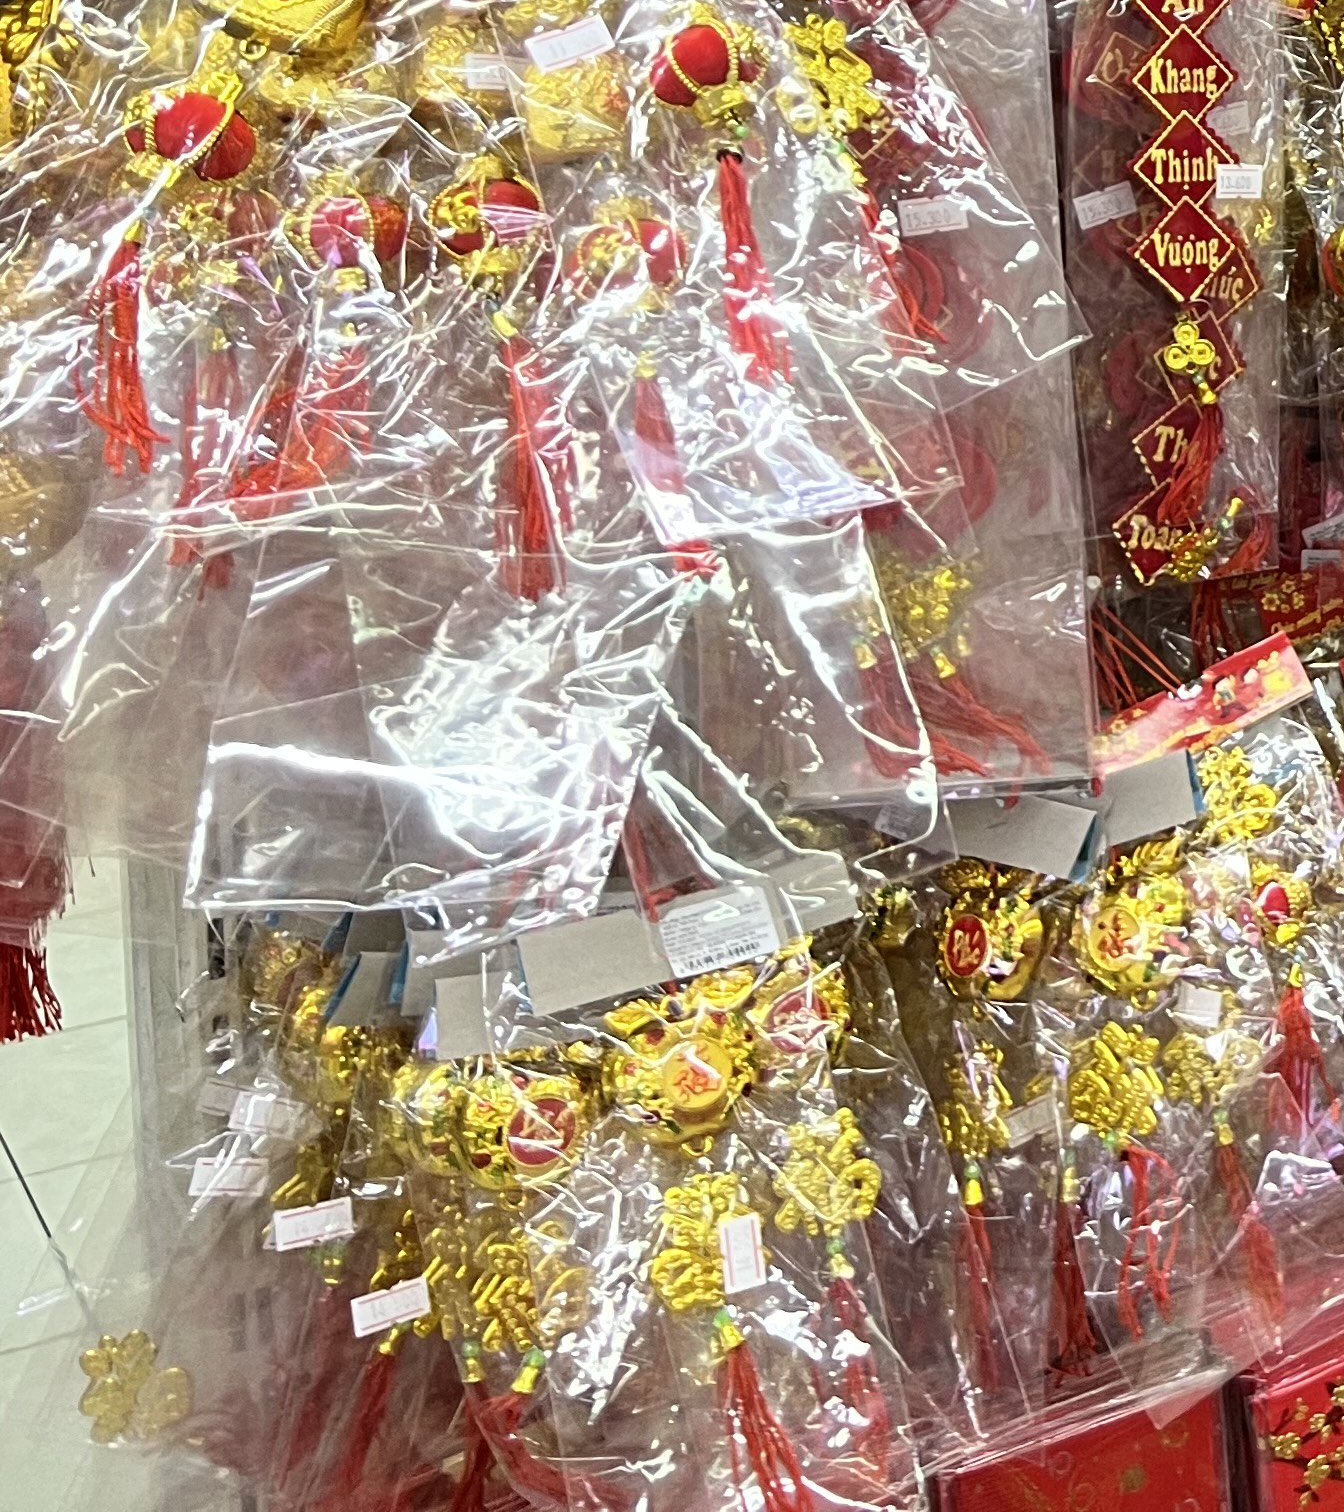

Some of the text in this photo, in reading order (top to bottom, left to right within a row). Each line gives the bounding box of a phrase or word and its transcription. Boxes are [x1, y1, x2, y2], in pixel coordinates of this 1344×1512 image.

[1150, 55, 1217, 96] Khang
[1151, 147, 1218, 190] Thịnh
[1153, 231, 1220, 275] Vượng
